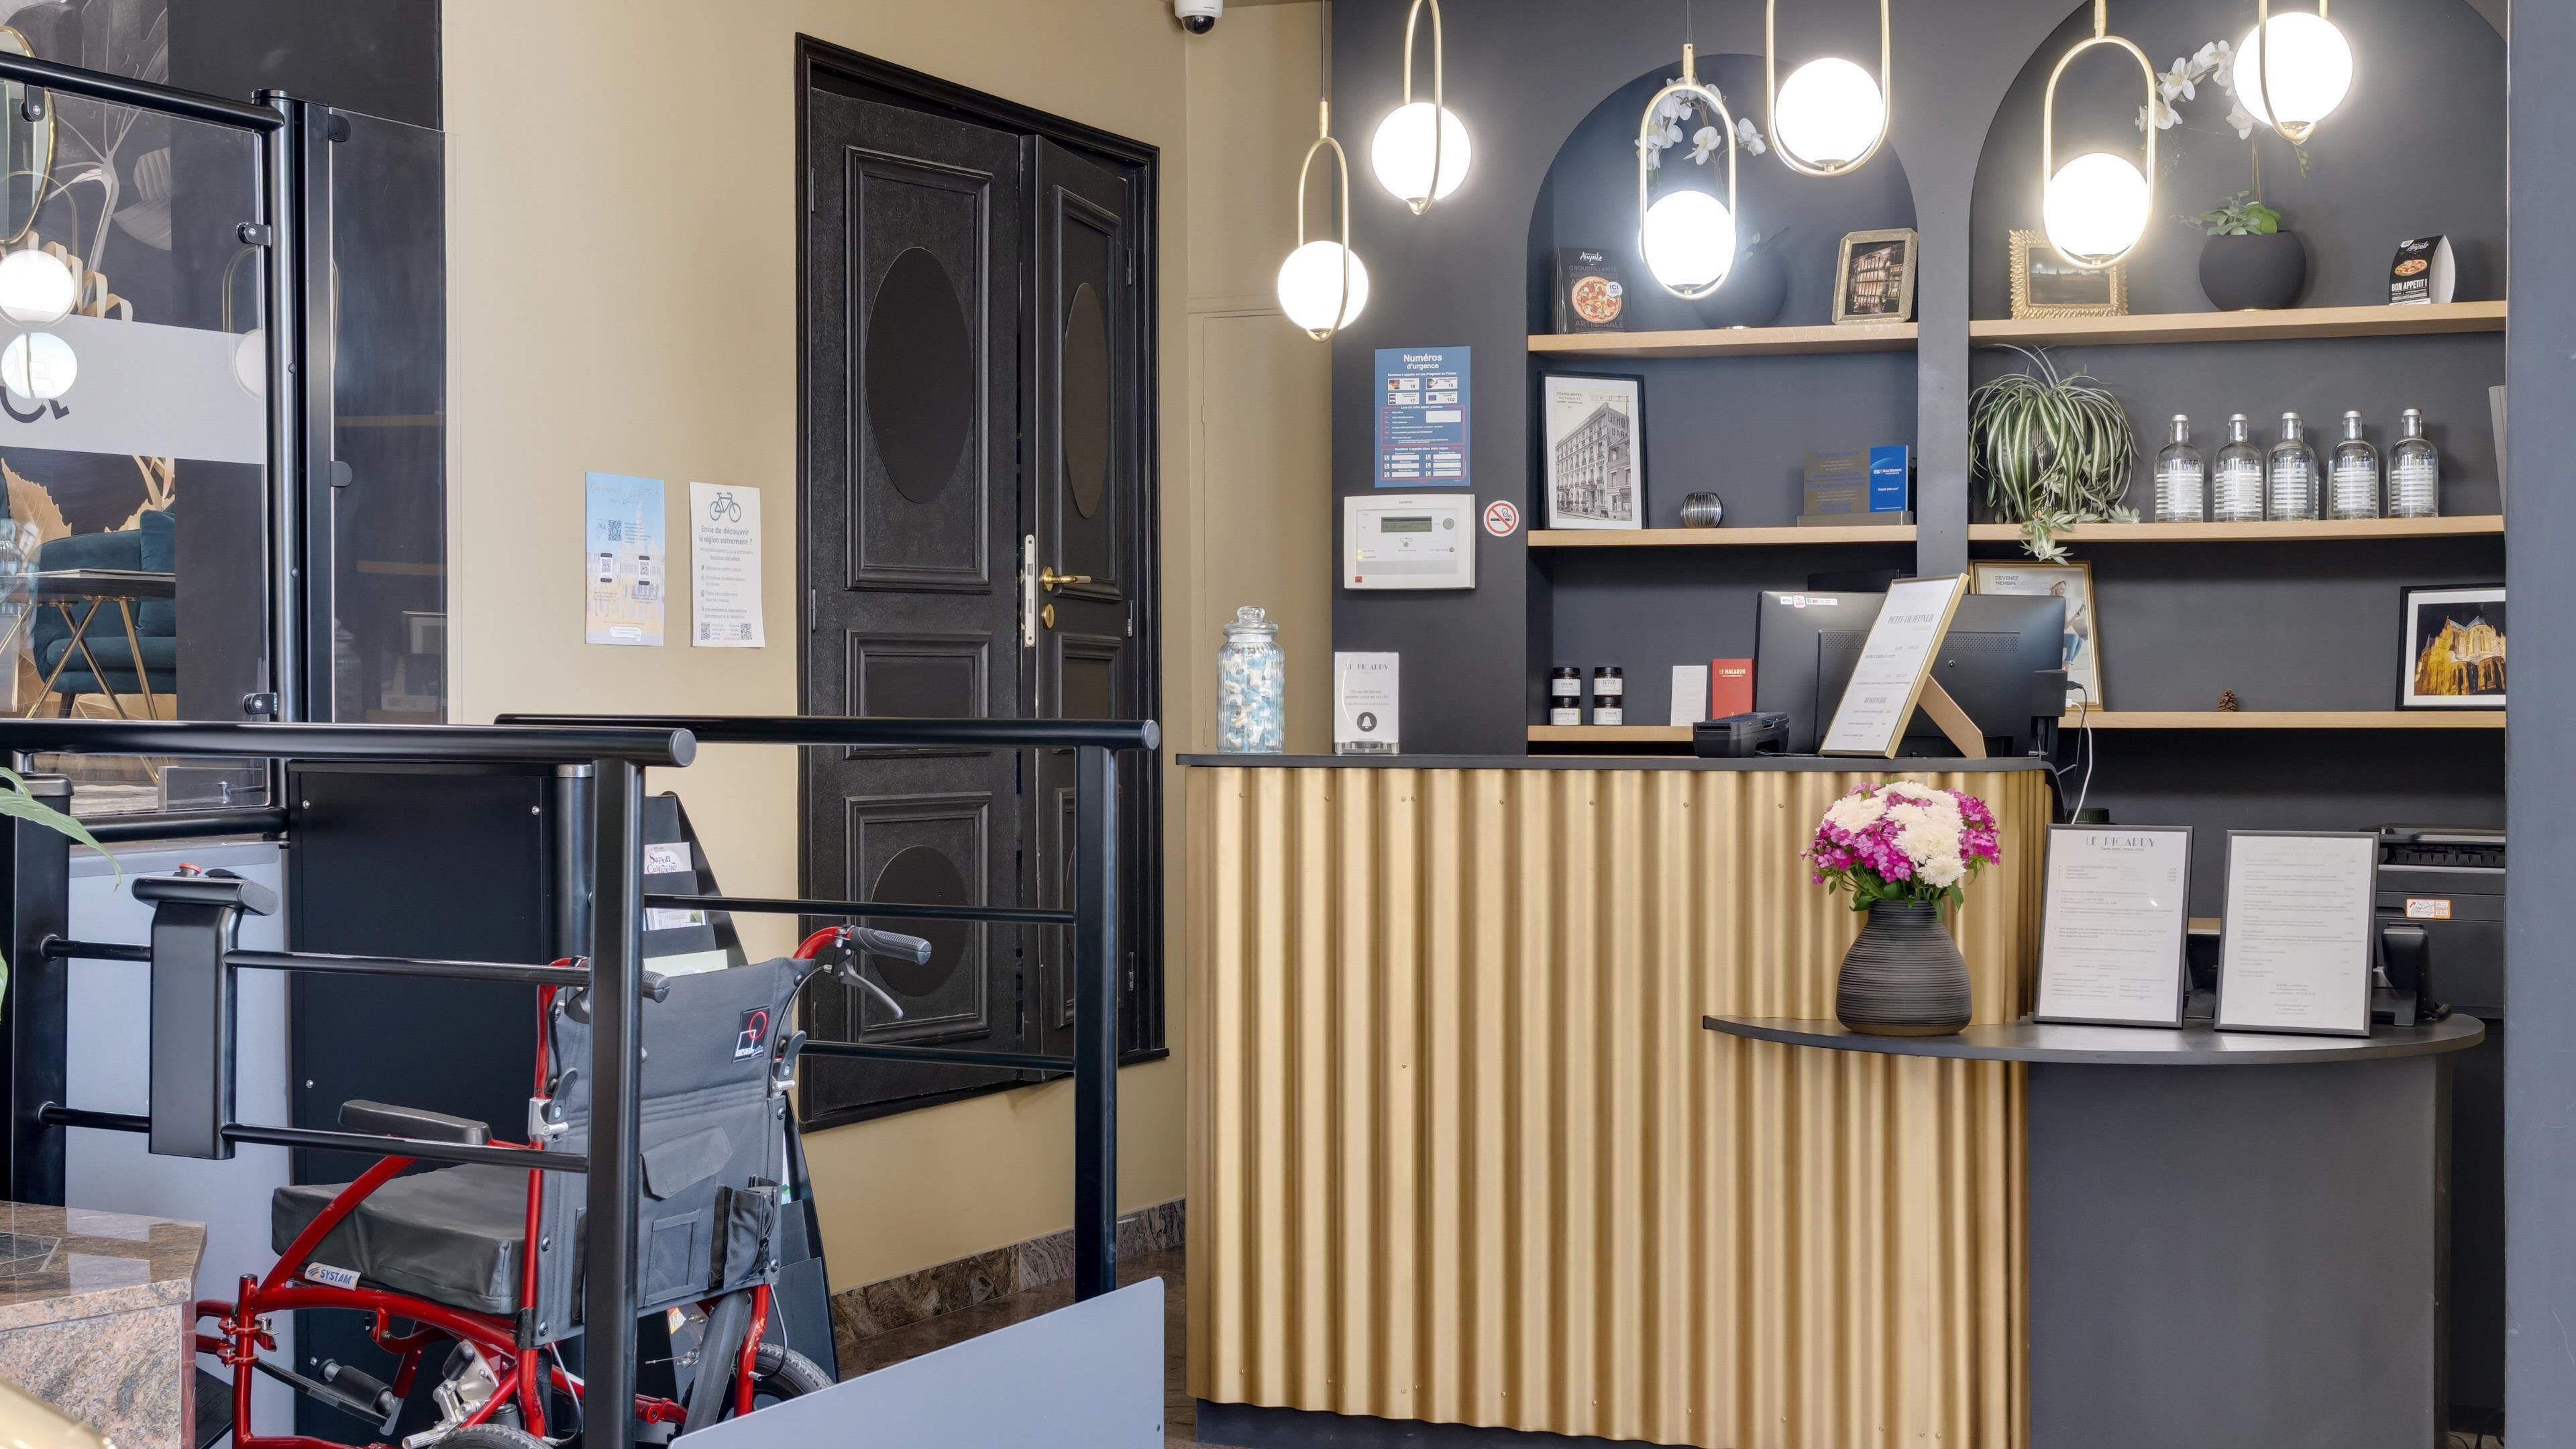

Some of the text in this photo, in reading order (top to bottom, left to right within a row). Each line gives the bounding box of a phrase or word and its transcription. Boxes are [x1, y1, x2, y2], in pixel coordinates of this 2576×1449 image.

[2392, 282, 2403, 291] BON
[2403, 278, 2424, 290] APPETIT
[1403, 354, 1442, 362] Numéros
[723, 527, 749, 535] découvrir
[704, 536, 719, 544] région
[2086, 837, 2098, 846] LE
[320, 1269, 353, 1285] SYSTAM
